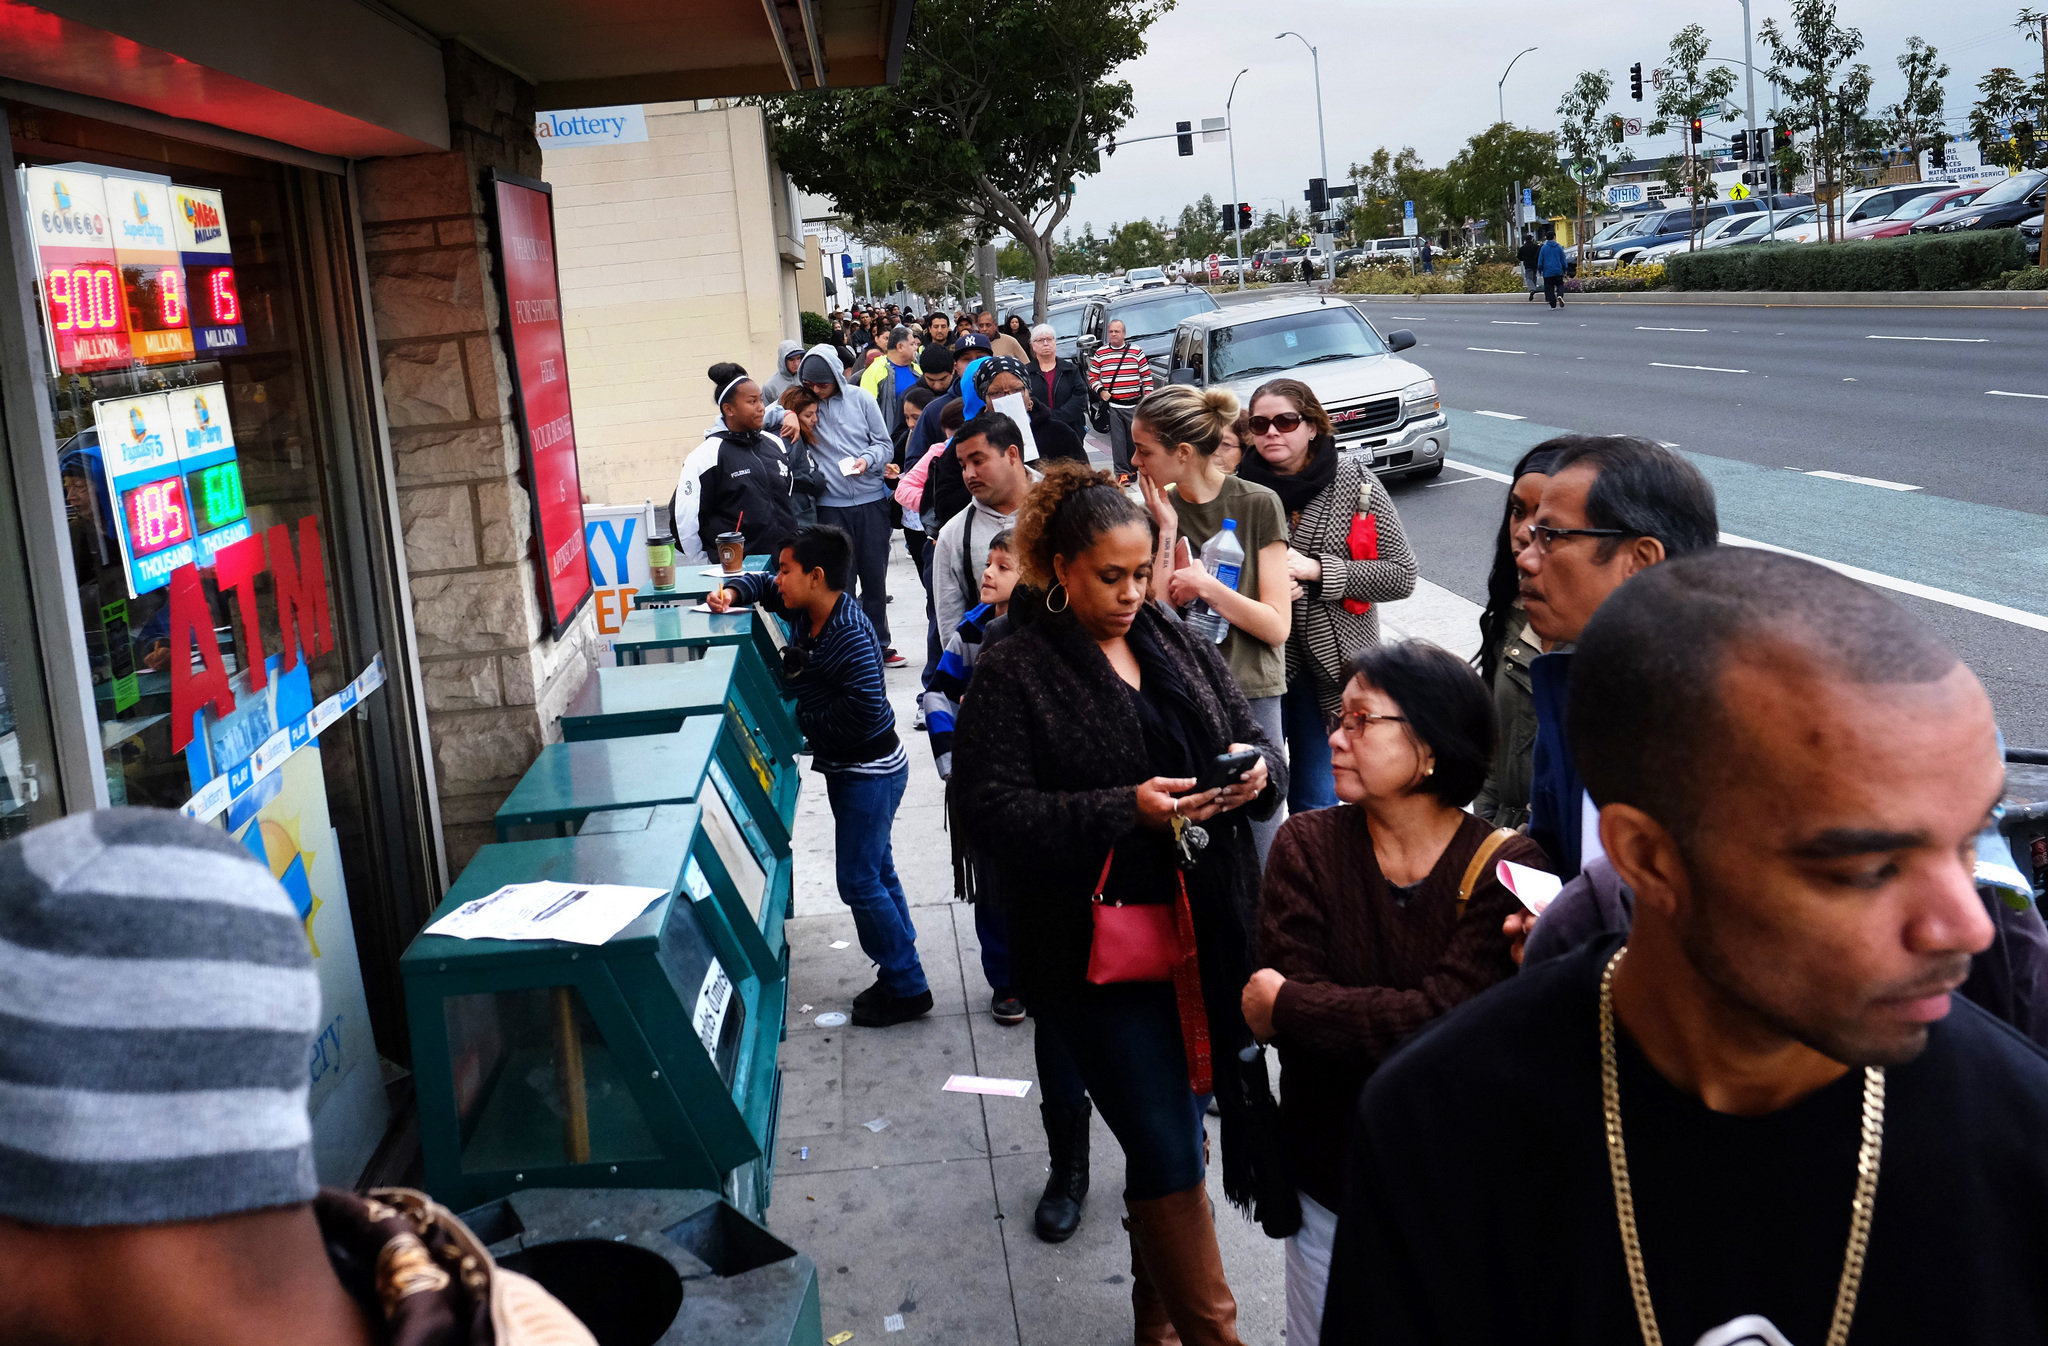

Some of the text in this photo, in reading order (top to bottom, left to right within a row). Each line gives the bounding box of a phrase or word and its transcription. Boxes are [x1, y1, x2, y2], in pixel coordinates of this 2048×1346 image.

[535, 114, 625, 138] alottery
[1980, 170, 2006, 178] SERVICE
[191, 199, 220, 228] MEGA
[194, 228, 222, 244] MILLIONS
[50, 269, 117, 330] 900
[161, 270, 181, 324] 8
[212, 271, 236, 320] 15
[515, 300, 532, 325] FOR
[73, 337, 120, 361] MILLION
[144, 332, 183, 353] MILLION
[204, 328, 238, 347] MILLION
[1327, 408, 1367, 424] GMC
[204, 464, 242, 526] 60
[684, 481, 693, 495] 3
[135, 481, 184, 547] 185
[202, 524, 248, 555] THOUSAND
[138, 544, 193, 580] THOUSAND
[169, 515, 334, 755] ATM
